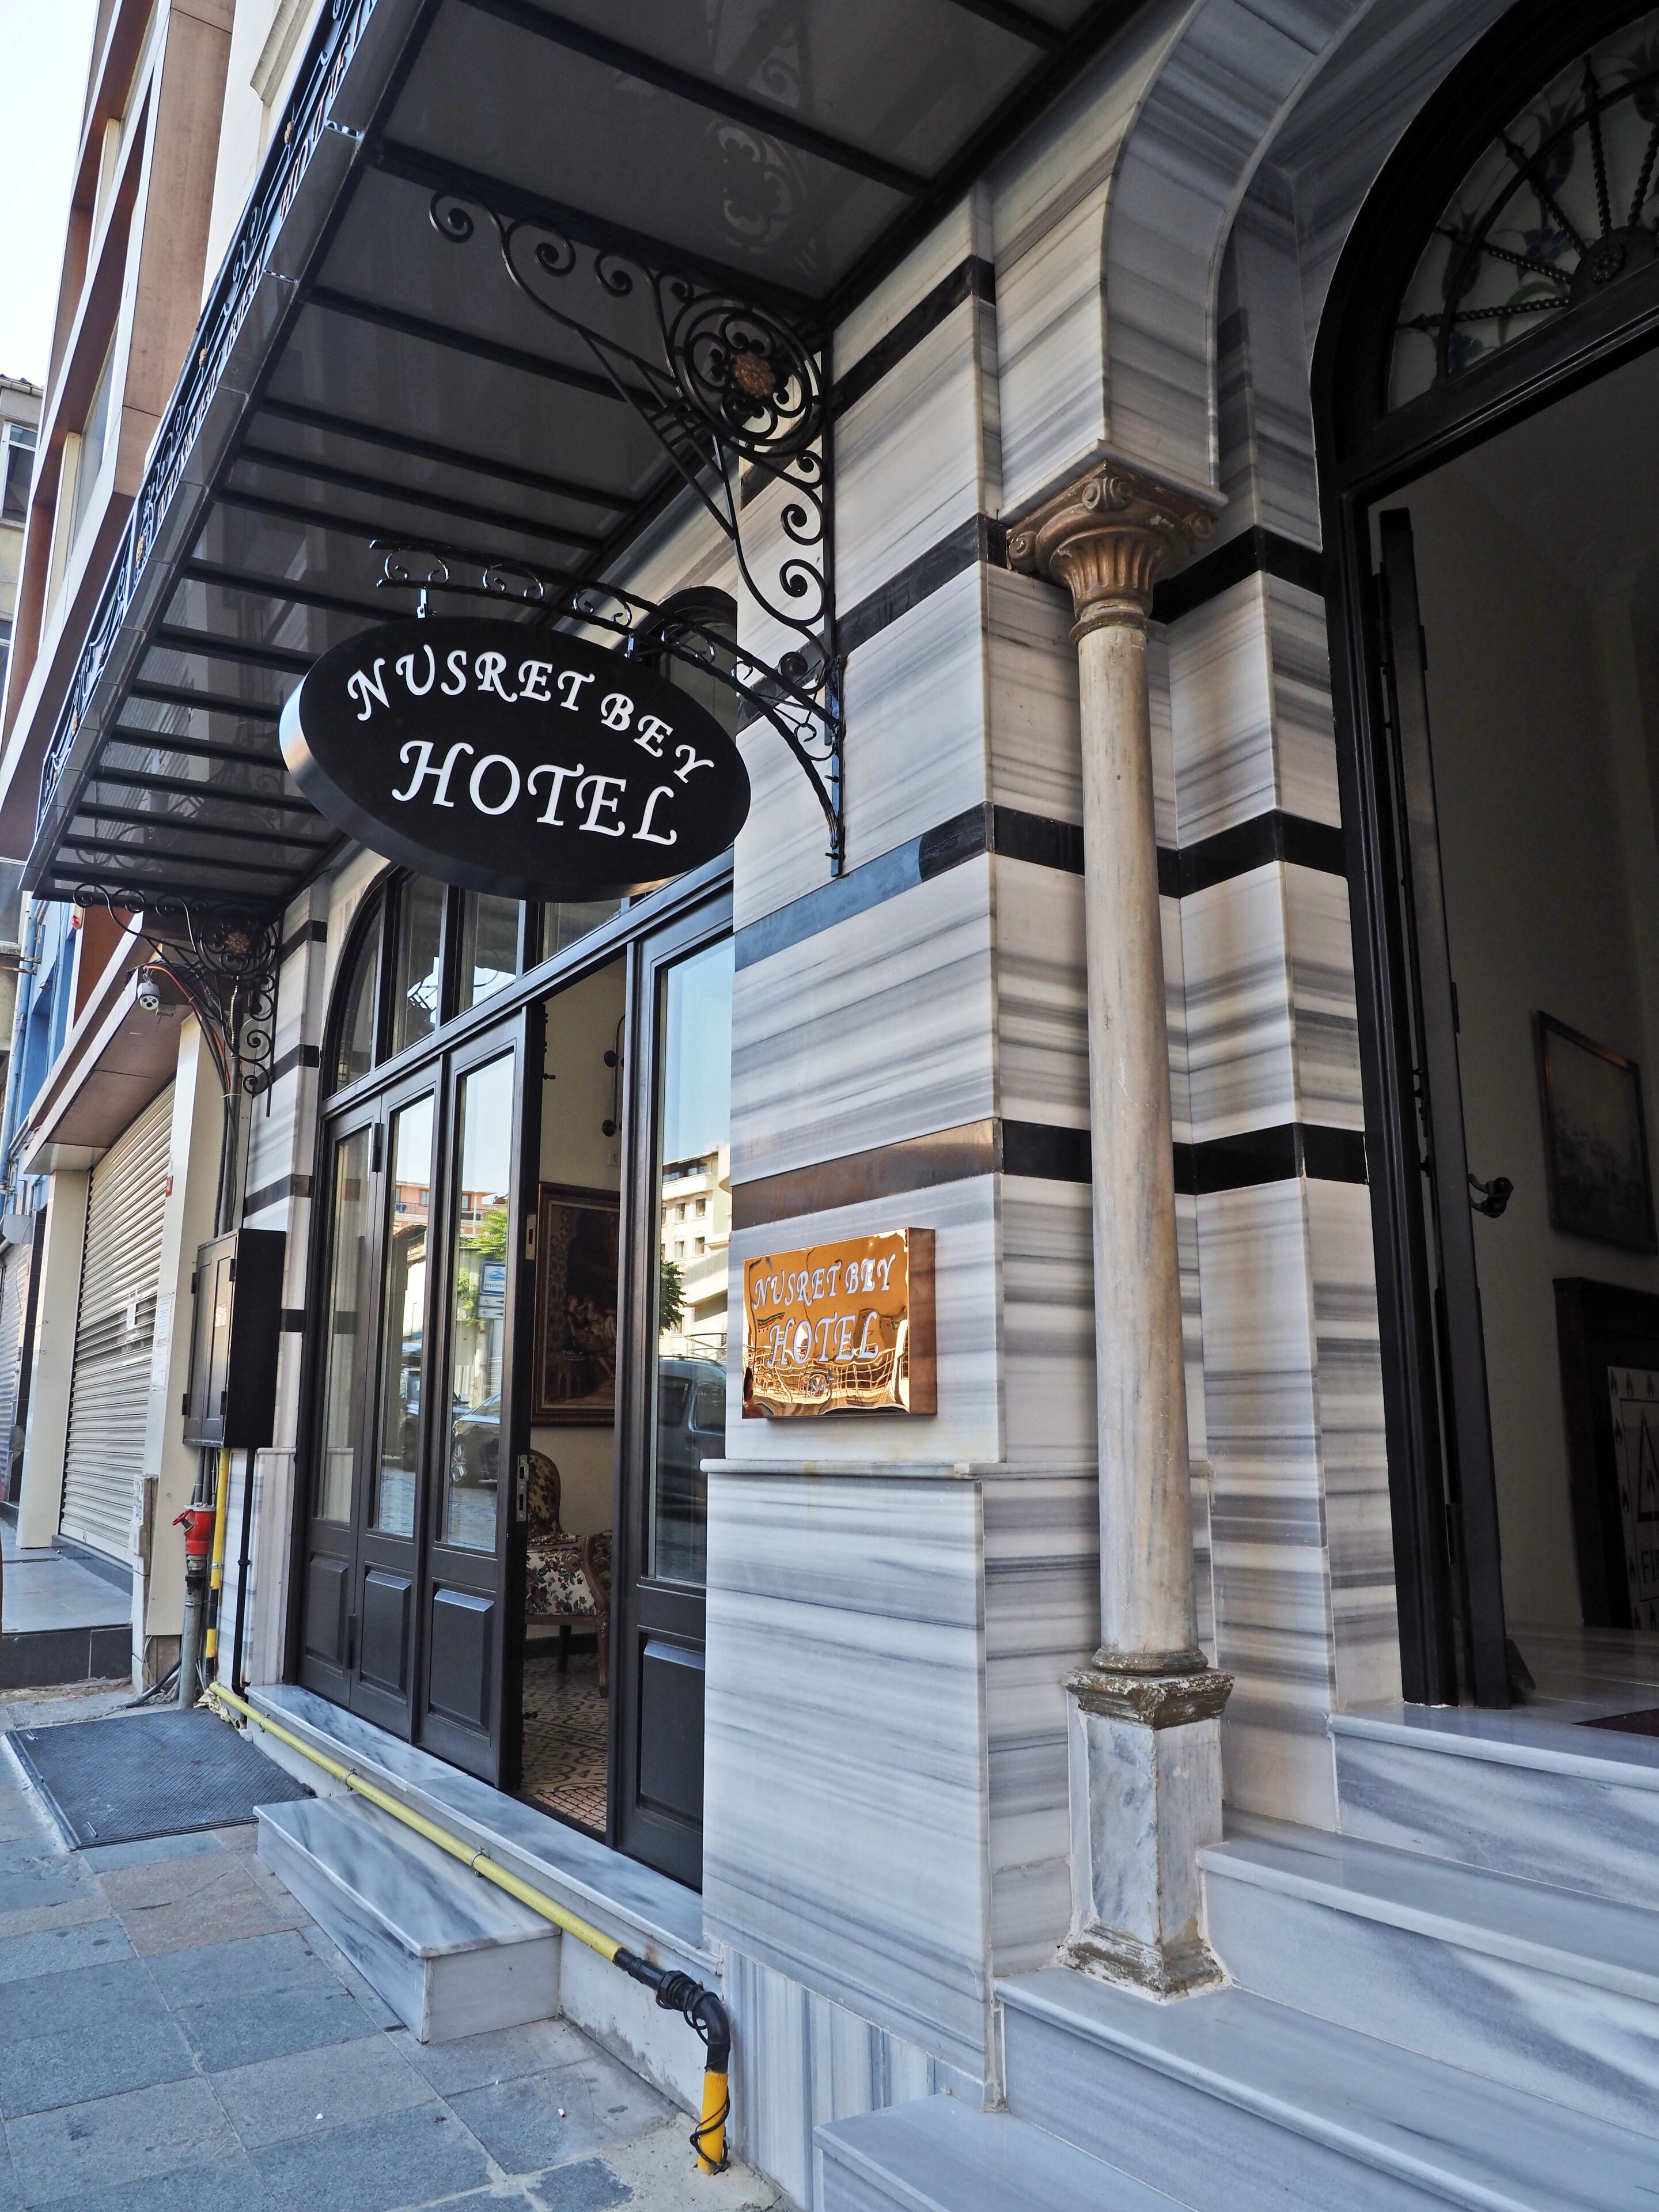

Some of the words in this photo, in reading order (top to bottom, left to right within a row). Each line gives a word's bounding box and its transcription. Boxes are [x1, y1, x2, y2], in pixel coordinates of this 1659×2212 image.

[347, 644, 595, 721] NUSRET
[600, 693, 714, 784] BEY
[392, 740, 677, 846] HOTEL
[753, 1260, 842, 1310] NUSRET
[845, 1253, 896, 1294] BEY
[767, 1312, 878, 1367] HOTEL
